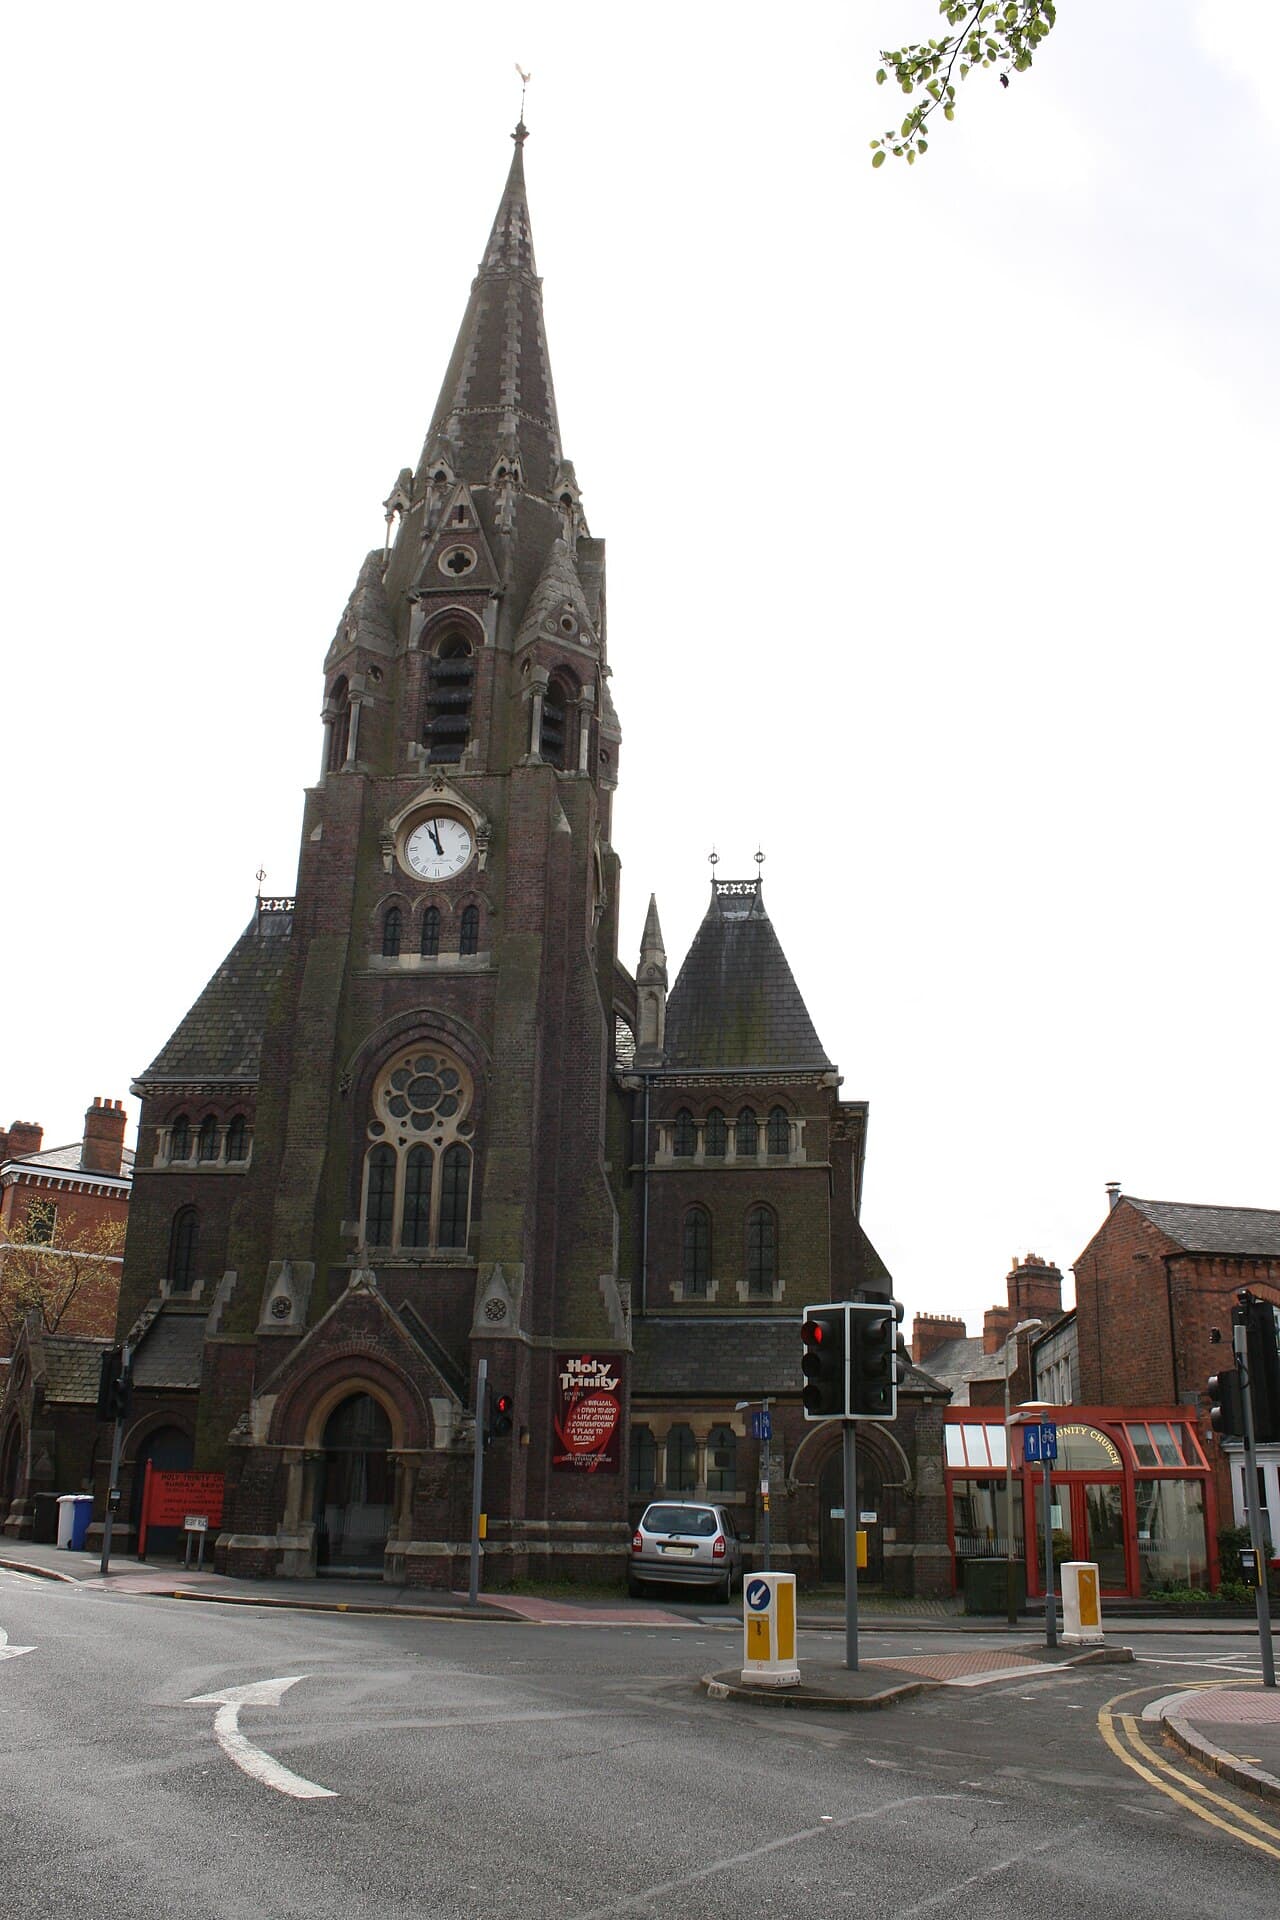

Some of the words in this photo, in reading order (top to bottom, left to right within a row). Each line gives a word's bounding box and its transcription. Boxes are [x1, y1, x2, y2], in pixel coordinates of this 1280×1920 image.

[566, 1360, 611, 1376] Holy
[559, 1373, 619, 1390] Trinity
[1056, 1427, 1088, 1438] UNITY
[1090, 1431, 1120, 1465] CHURCH
